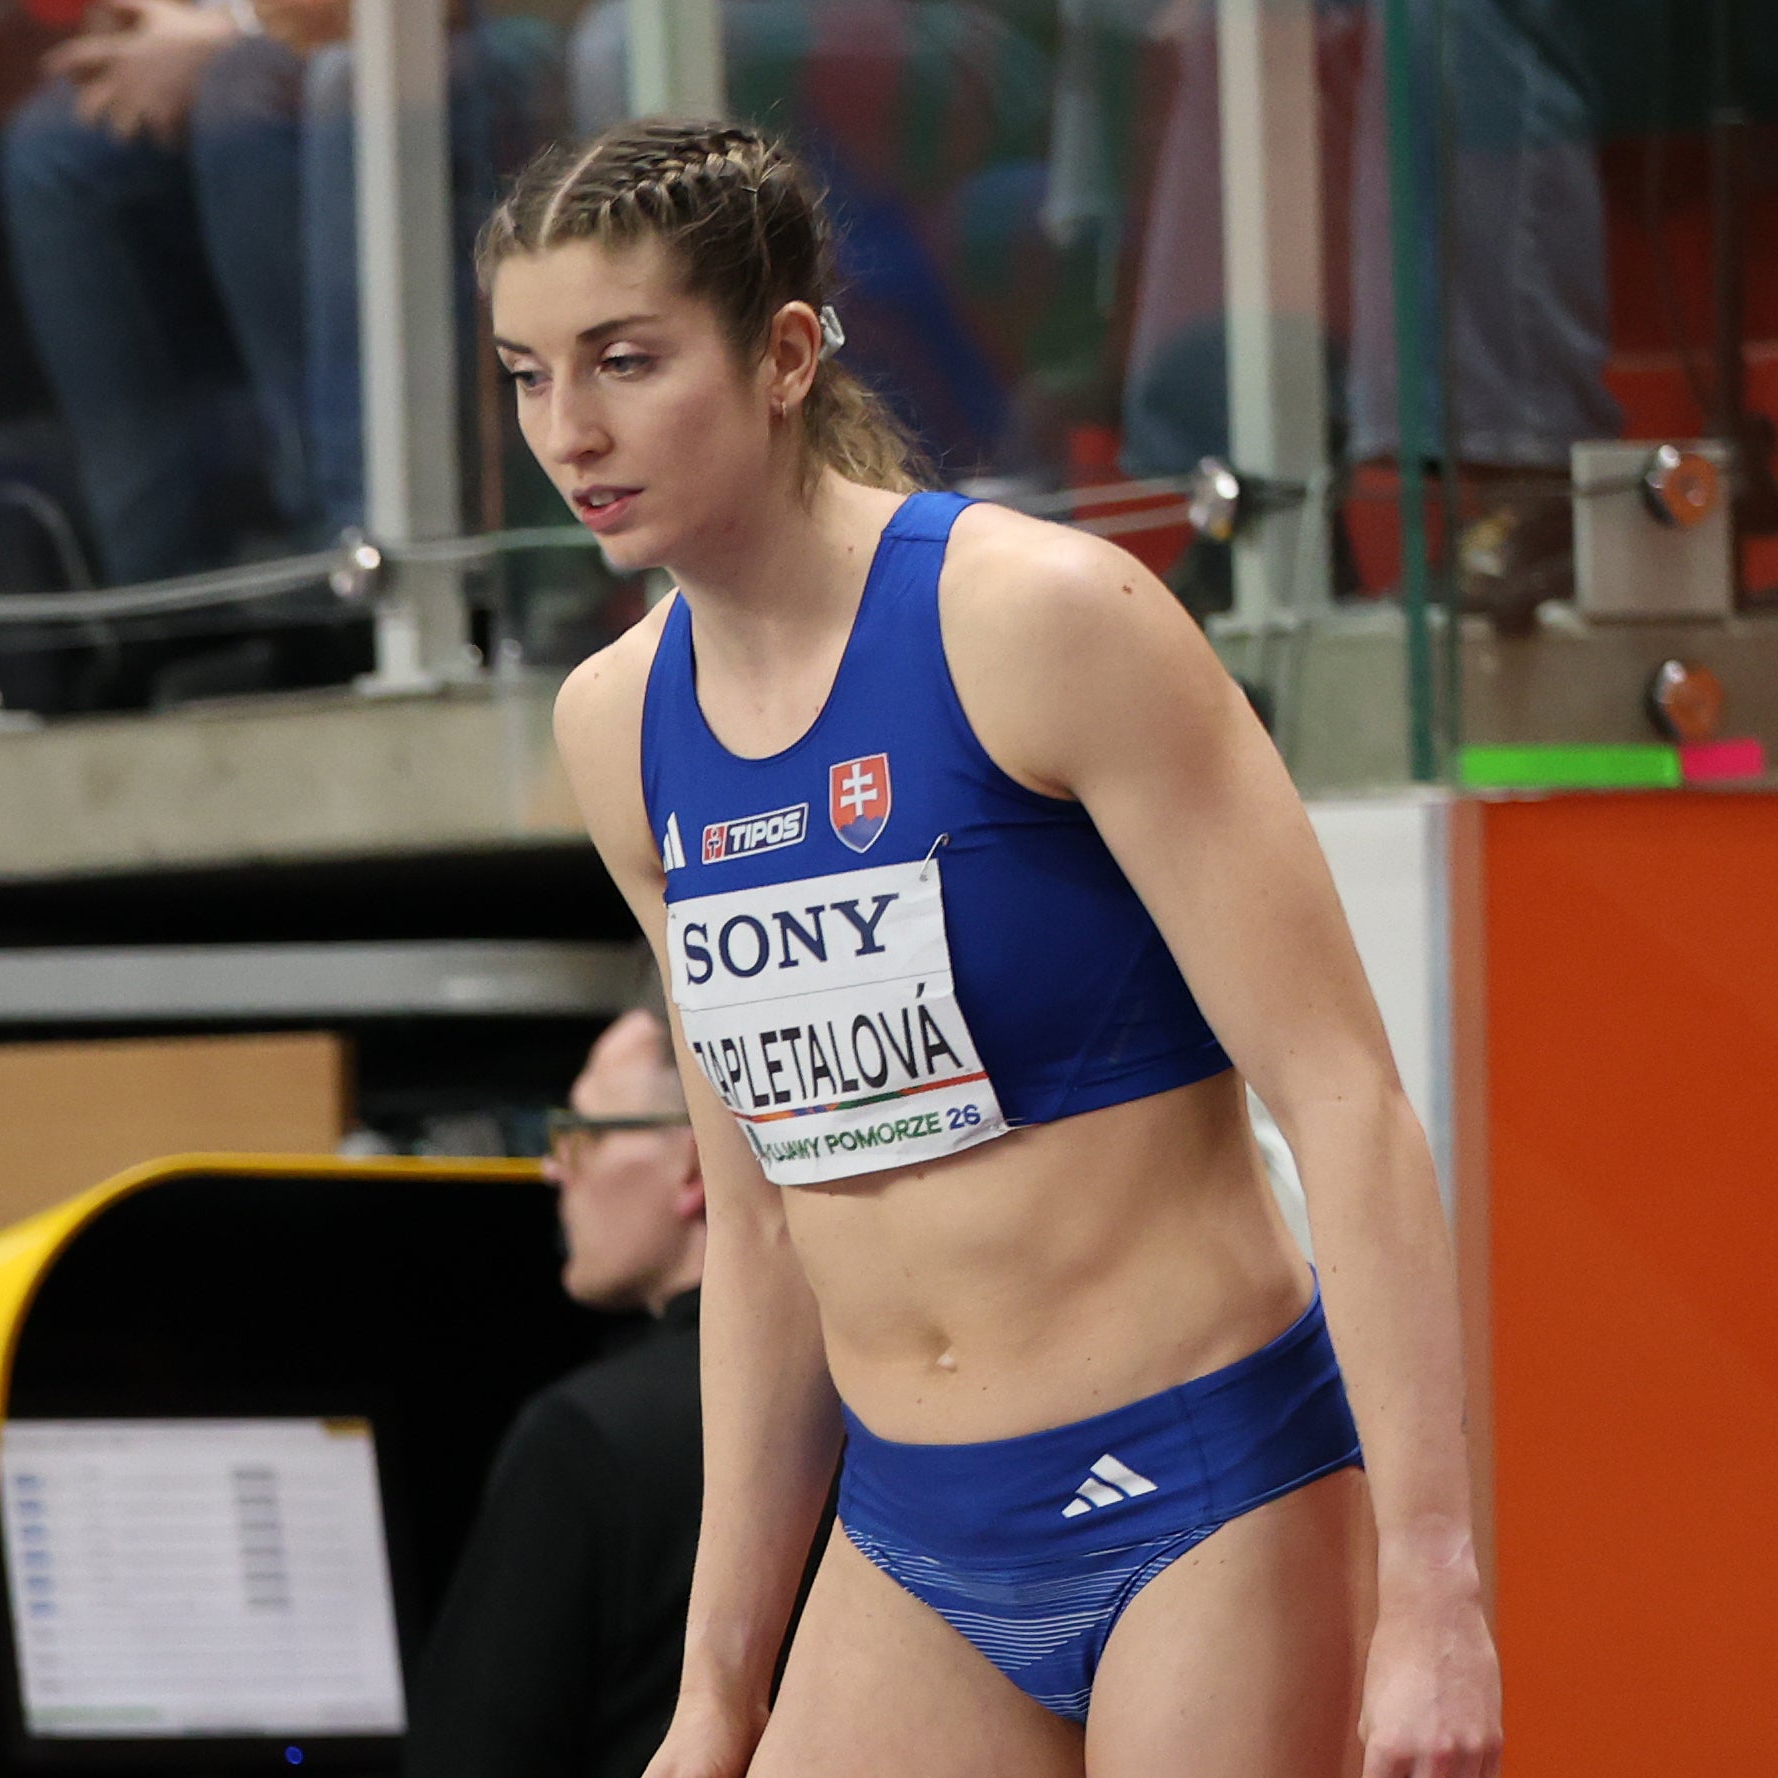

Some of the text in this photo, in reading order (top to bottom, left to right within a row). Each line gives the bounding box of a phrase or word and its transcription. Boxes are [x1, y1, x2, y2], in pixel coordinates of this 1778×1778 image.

[729, 810, 802, 852] TIPOS
[683, 892, 900, 986] SONY
[824, 1111, 943, 1155] POMORZE
[945, 1103, 982, 1131] 26
